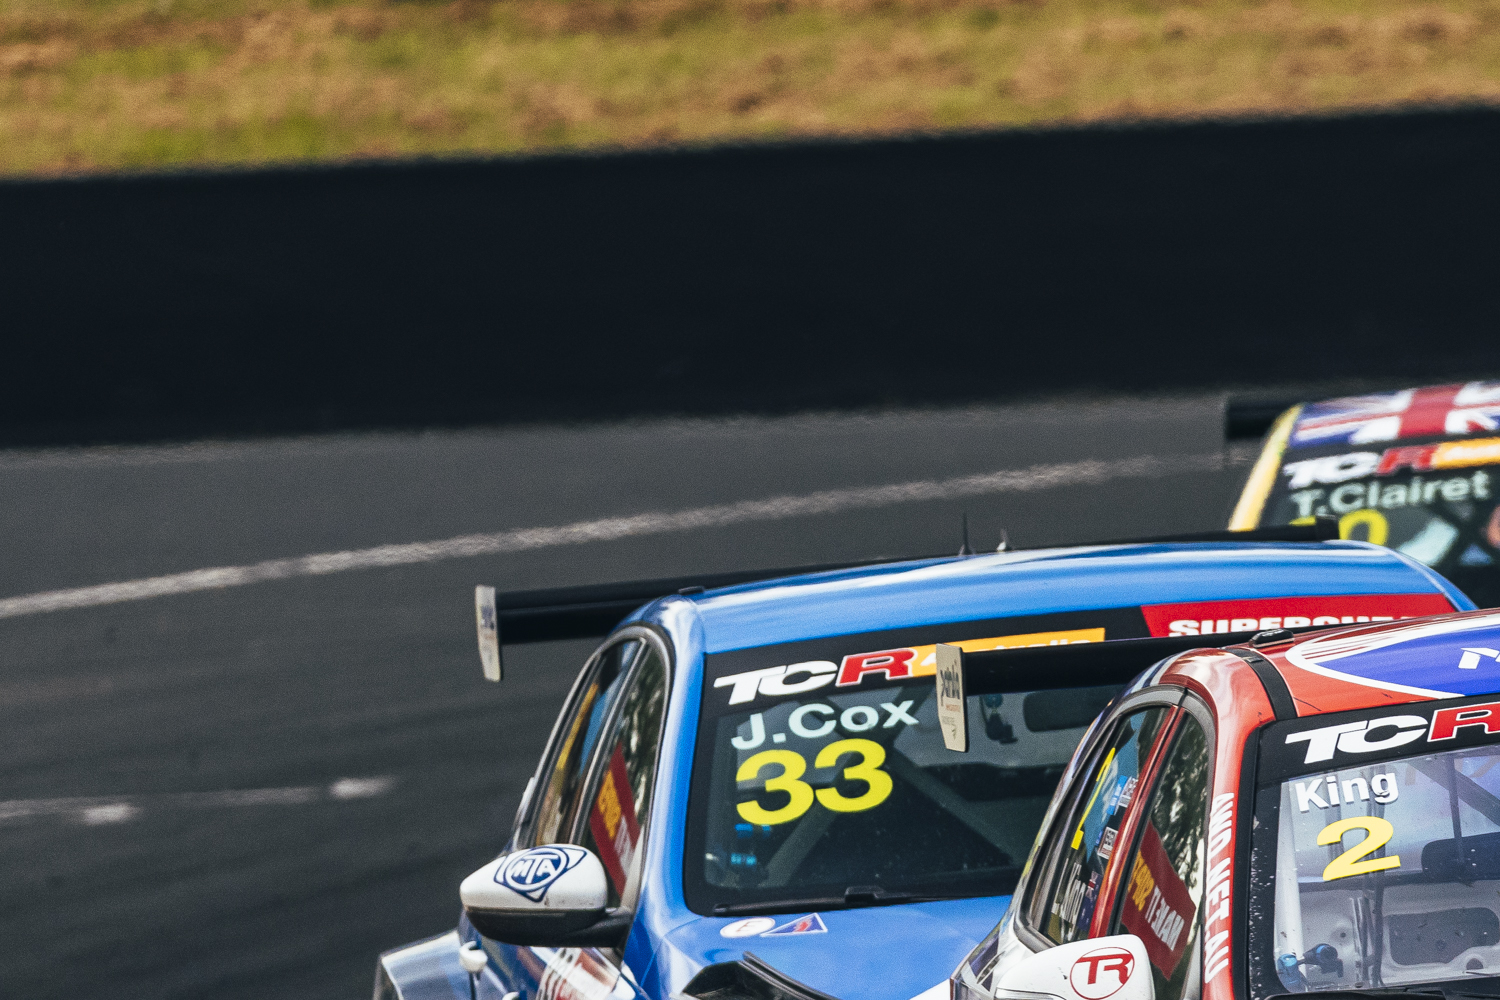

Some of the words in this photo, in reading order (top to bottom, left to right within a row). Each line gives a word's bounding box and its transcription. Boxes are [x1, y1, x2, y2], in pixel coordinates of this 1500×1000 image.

[1288, 470, 1490, 518] T.Clairet
[714, 648, 917, 705] TCR
[731, 700, 919, 749] J.Cox
[736, 738, 893, 826] 33
[1295, 769, 1400, 813] King
[1317, 815, 1401, 881] 2
